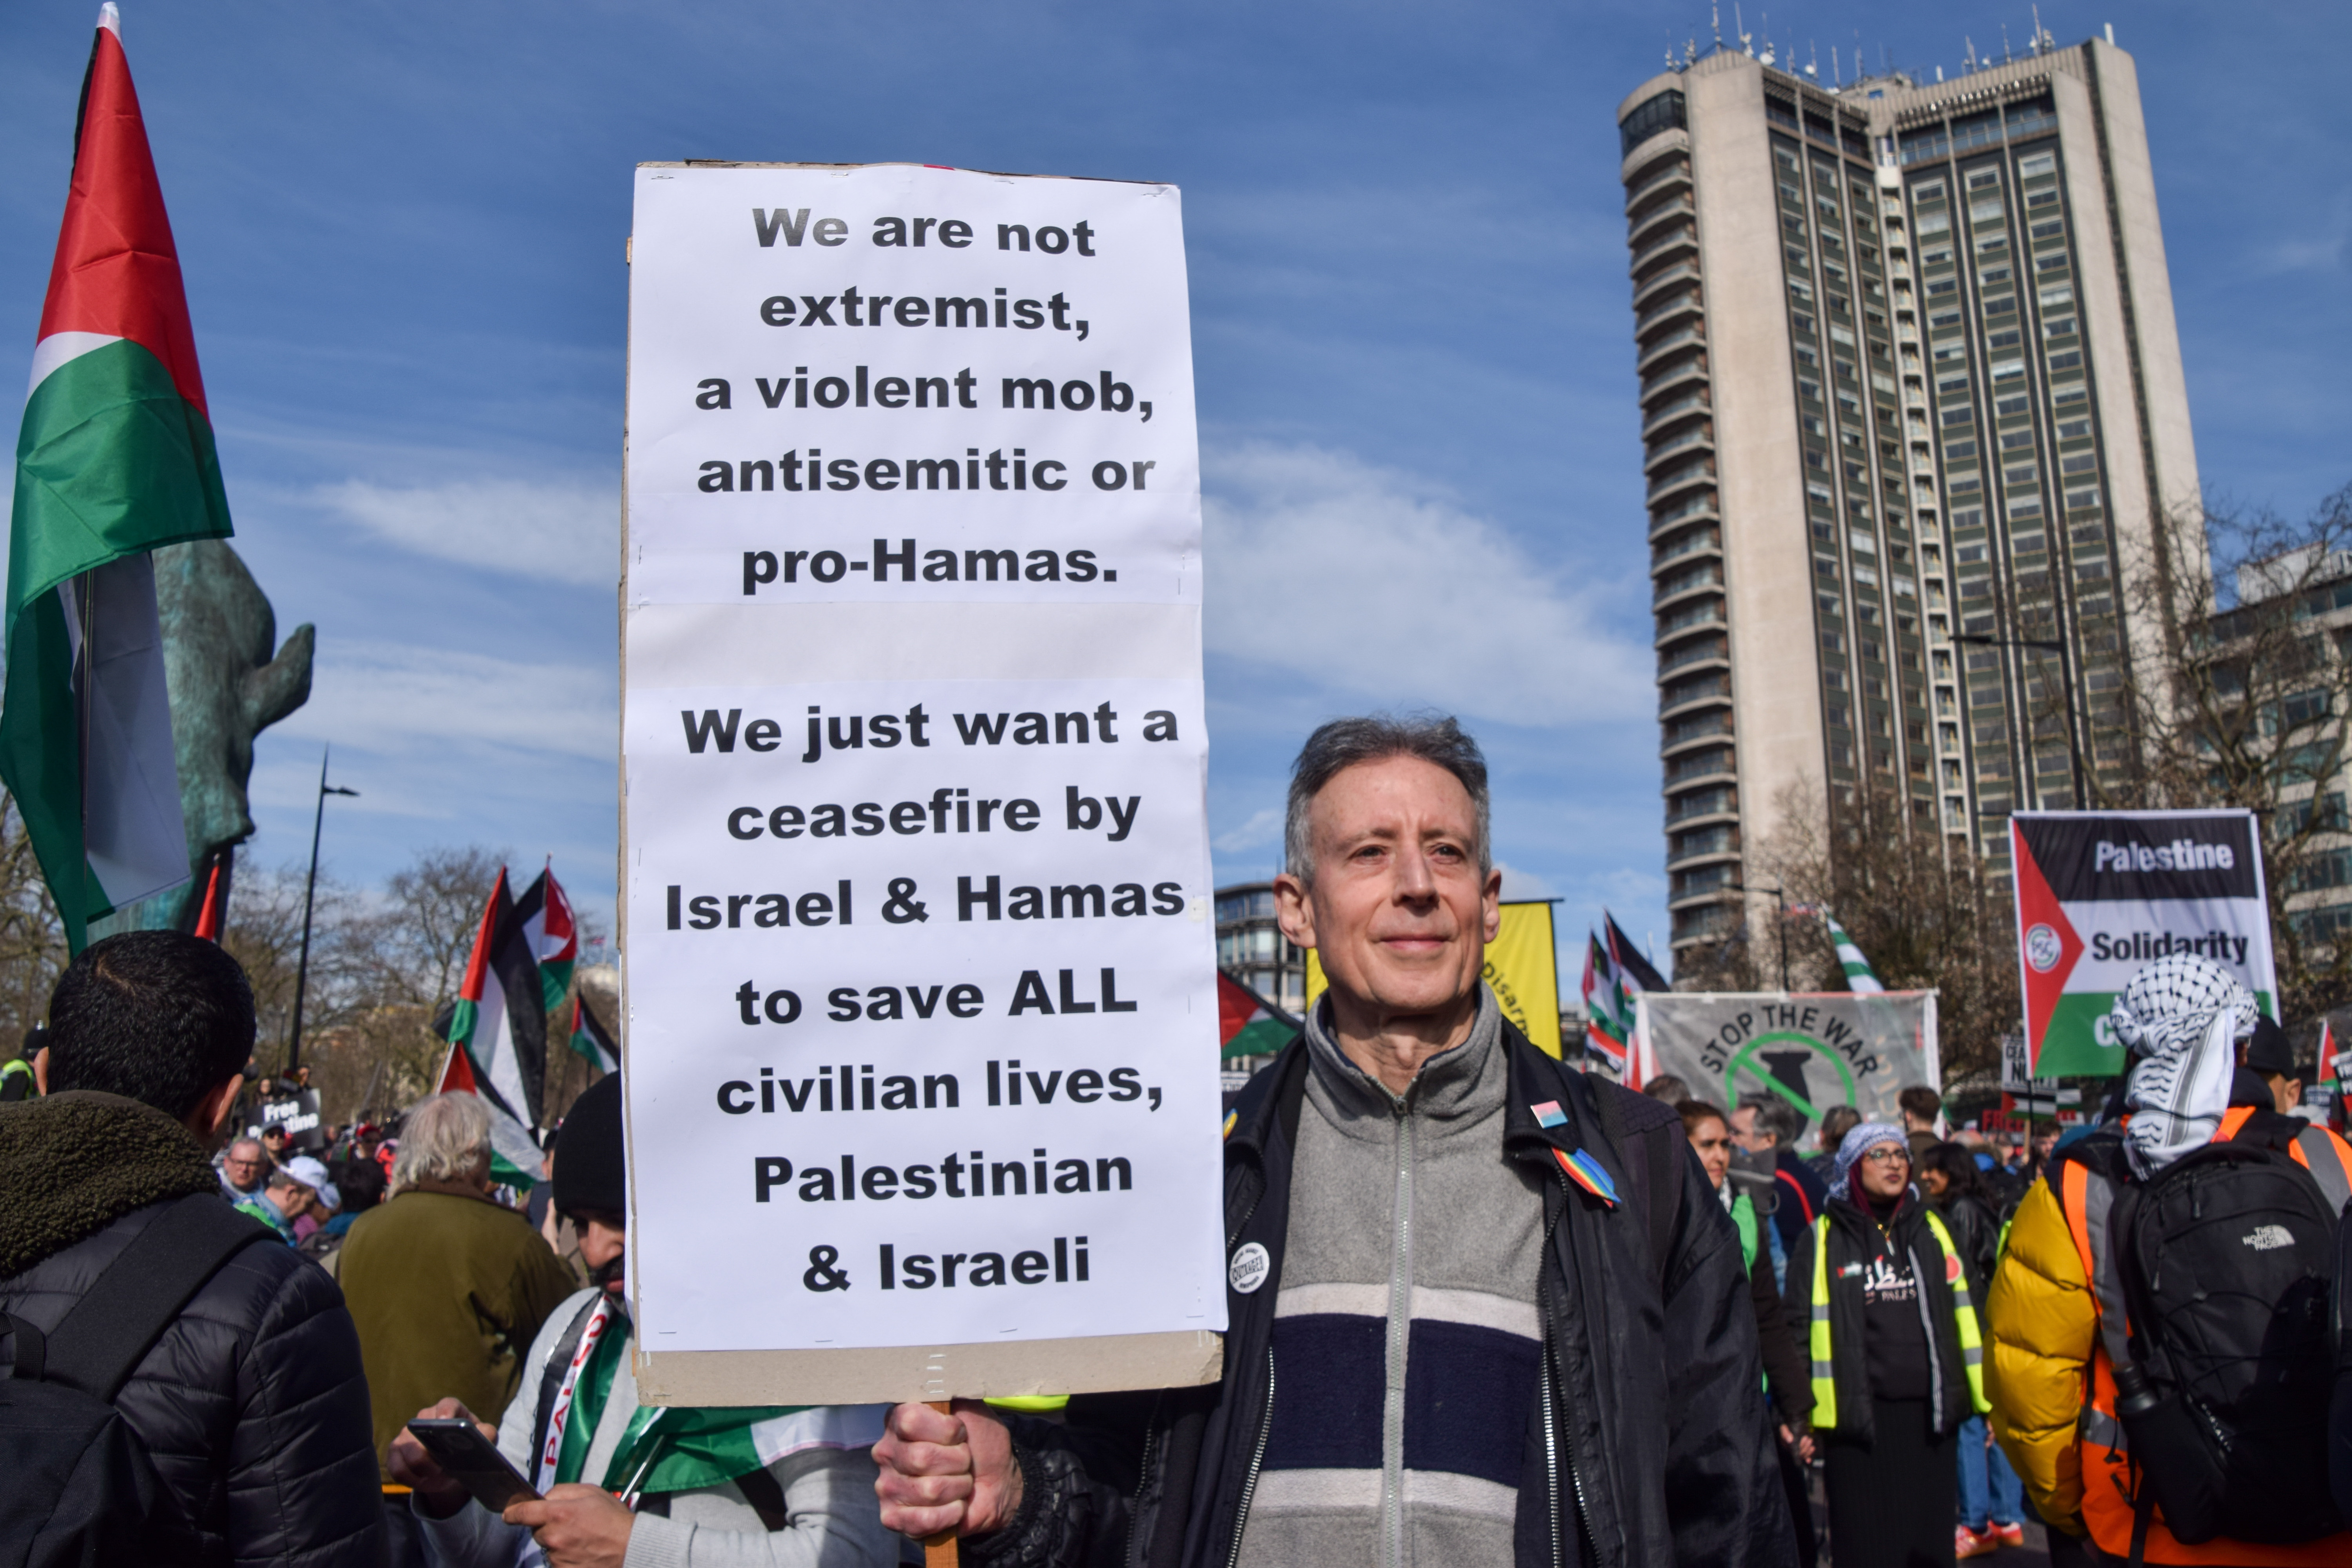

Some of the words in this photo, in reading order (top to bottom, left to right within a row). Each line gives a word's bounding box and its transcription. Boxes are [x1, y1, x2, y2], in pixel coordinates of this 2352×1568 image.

[753, 209, 848, 247] We
[873, 217, 973, 248] are
[998, 220, 1096, 257] not
[760, 286, 1089, 341] extremist,
[696, 378, 731, 410] a
[755, 366, 977, 409] violent
[1002, 370, 1152, 423] mob,
[698, 448, 1068, 493] antisemitic
[1092, 461, 1156, 491] or
[743, 538, 1117, 596] pro-Hamas.
[681, 708, 782, 754] We
[802, 703, 930, 763] just
[952, 700, 1119, 746] want
[1143, 710, 1178, 742] a
[727, 788, 1041, 840] ceasefire
[1066, 786, 1141, 842] by
[2095, 838, 2234, 872] Palestine
[667, 879, 852, 931] Israel
[882, 877, 930, 924] &
[957, 875, 1184, 922] Hamas
[2092, 930, 2249, 965] Solidarity
[735, 979, 803, 1026] to
[827, 983, 984, 1022] save
[1008, 967, 1137, 1016] ALL
[1700, 1012, 1753, 1074] STOP
[1760, 1004, 1820, 1032] THE
[1824, 1016, 1878, 1079] WAR
[263, 1101, 300, 1122] Free
[717, 1064, 959, 1115] civilian
[986, 1059, 1162, 1112] lives,
[755, 1148, 1132, 1203] Palestinian
[2242, 1233, 2273, 1246] NORTH
[2255, 1226, 2273, 1235] THE
[2255, 1240, 2278, 1251] FACE
[803, 1244, 851, 1292] &
[879, 1235, 1089, 1290] Israeli
